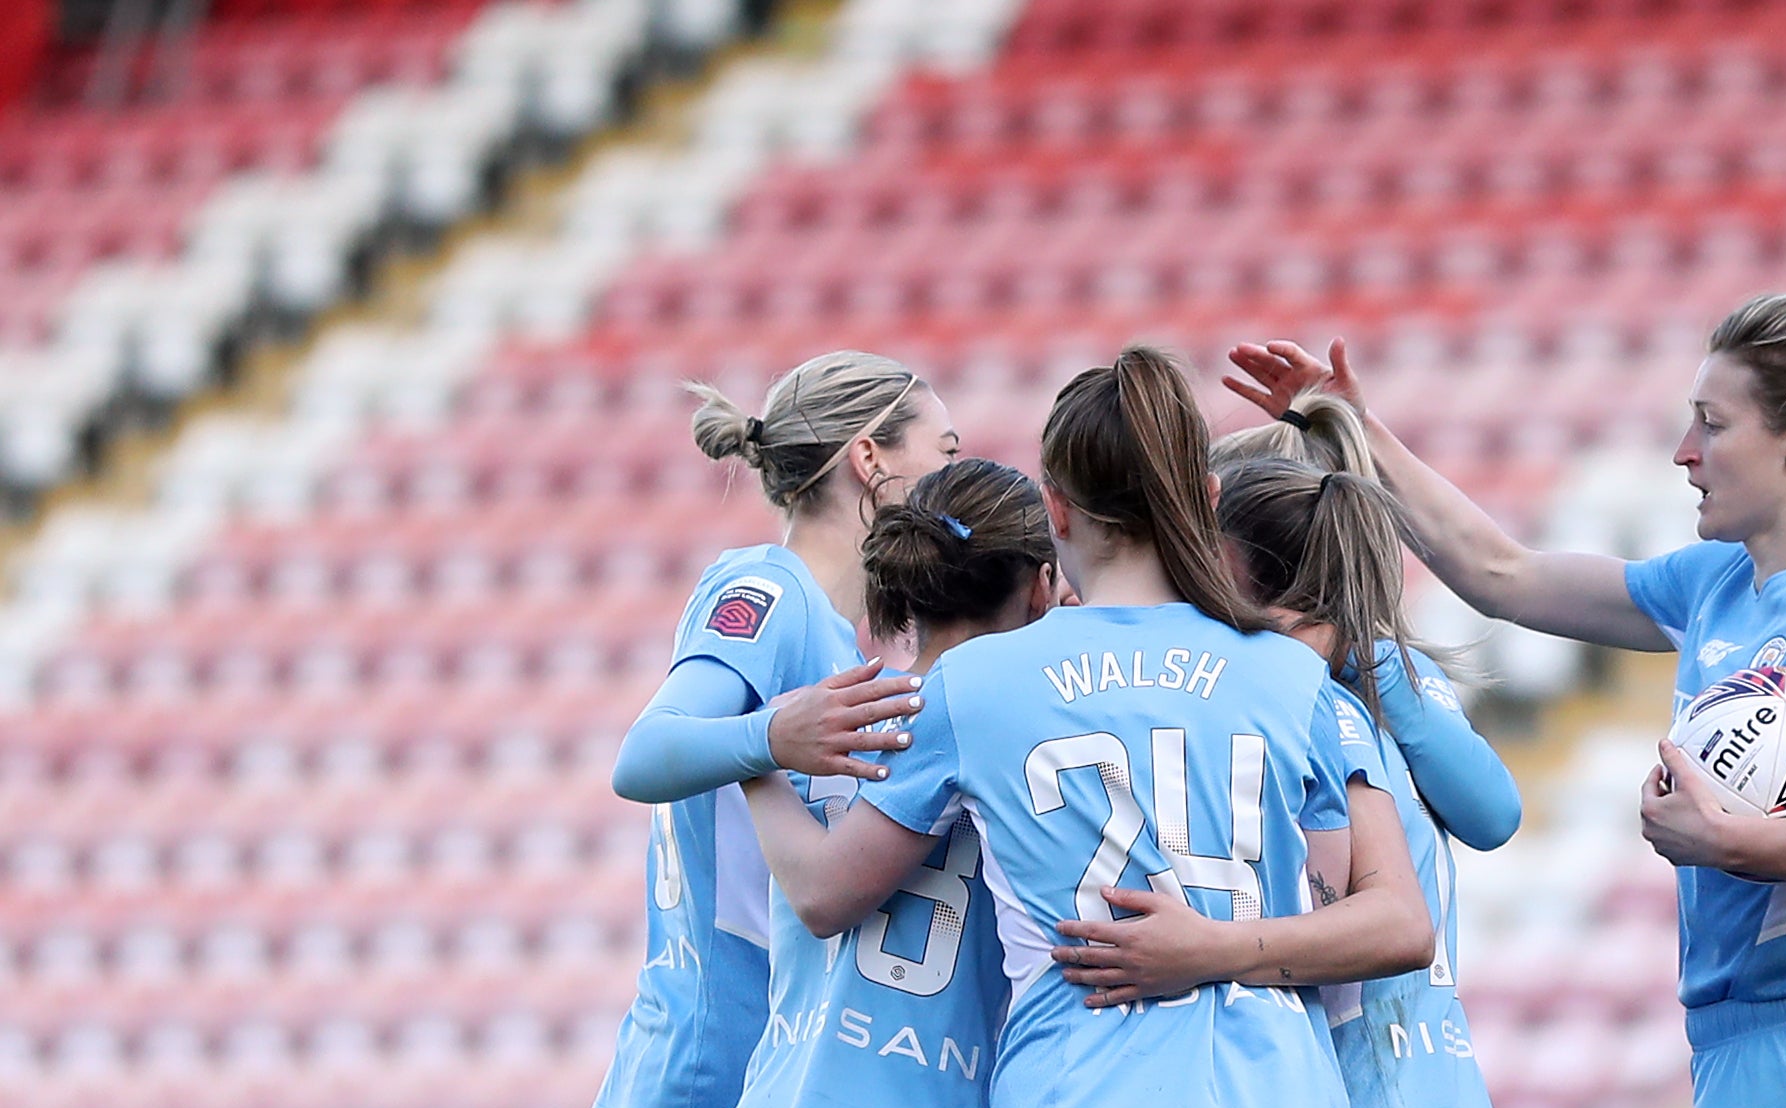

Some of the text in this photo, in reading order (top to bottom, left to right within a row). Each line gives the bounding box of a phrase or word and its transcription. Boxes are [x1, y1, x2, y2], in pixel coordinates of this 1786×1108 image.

[1043, 648, 1228, 703] WALSH
[1712, 707, 1777, 780] mitre
[1024, 727, 1266, 946] 24
[772, 1001, 981, 1081] NISSAN
